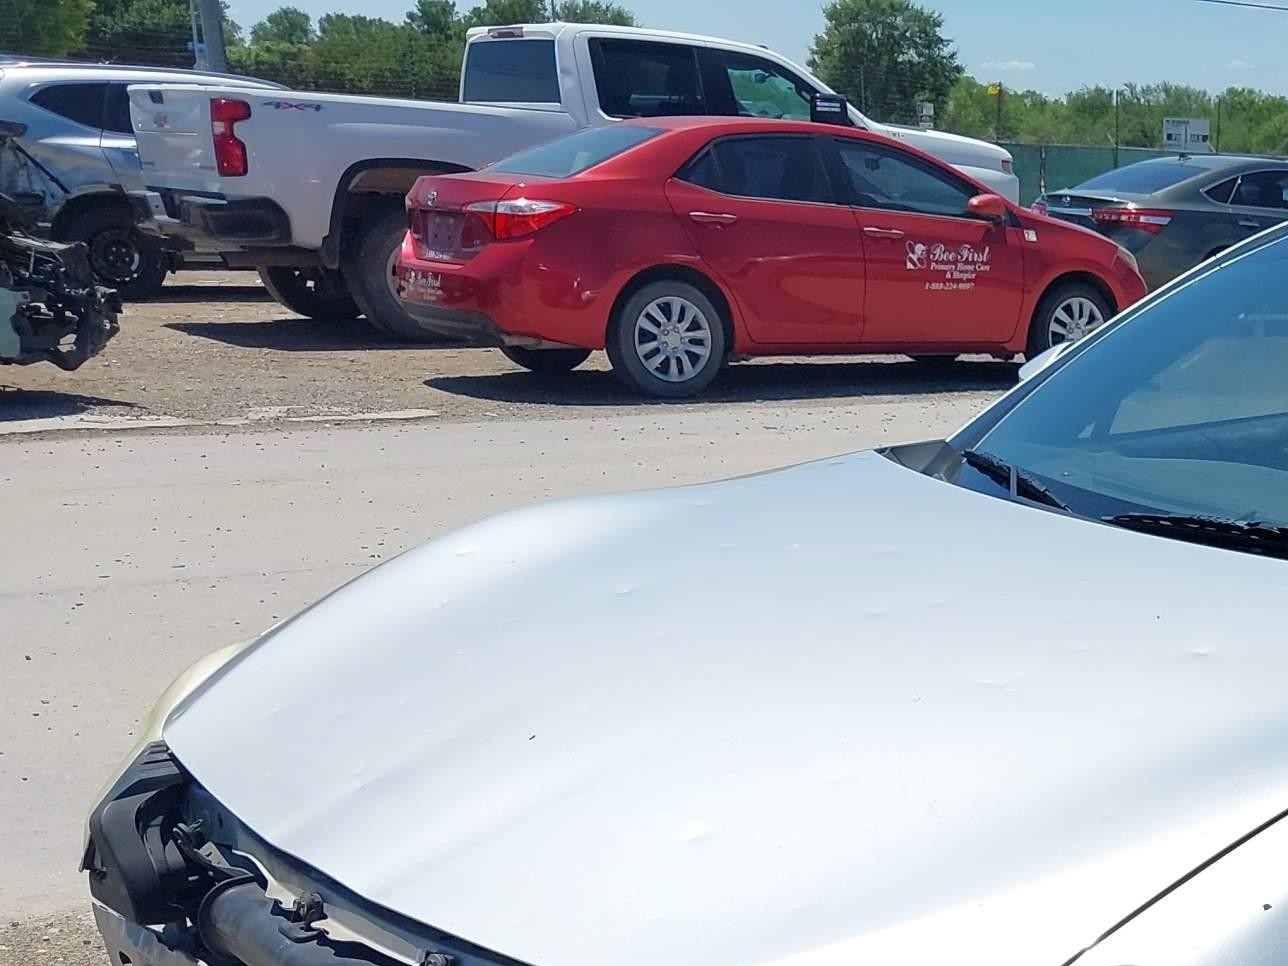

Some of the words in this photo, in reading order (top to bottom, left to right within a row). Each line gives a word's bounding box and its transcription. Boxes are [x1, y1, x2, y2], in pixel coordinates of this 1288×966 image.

[930, 243, 955, 261] Bee
[957, 244, 990, 262] First
[930, 262, 956, 271] Primary
[957, 263, 975, 271] Home
[976, 263, 991, 271] Care
